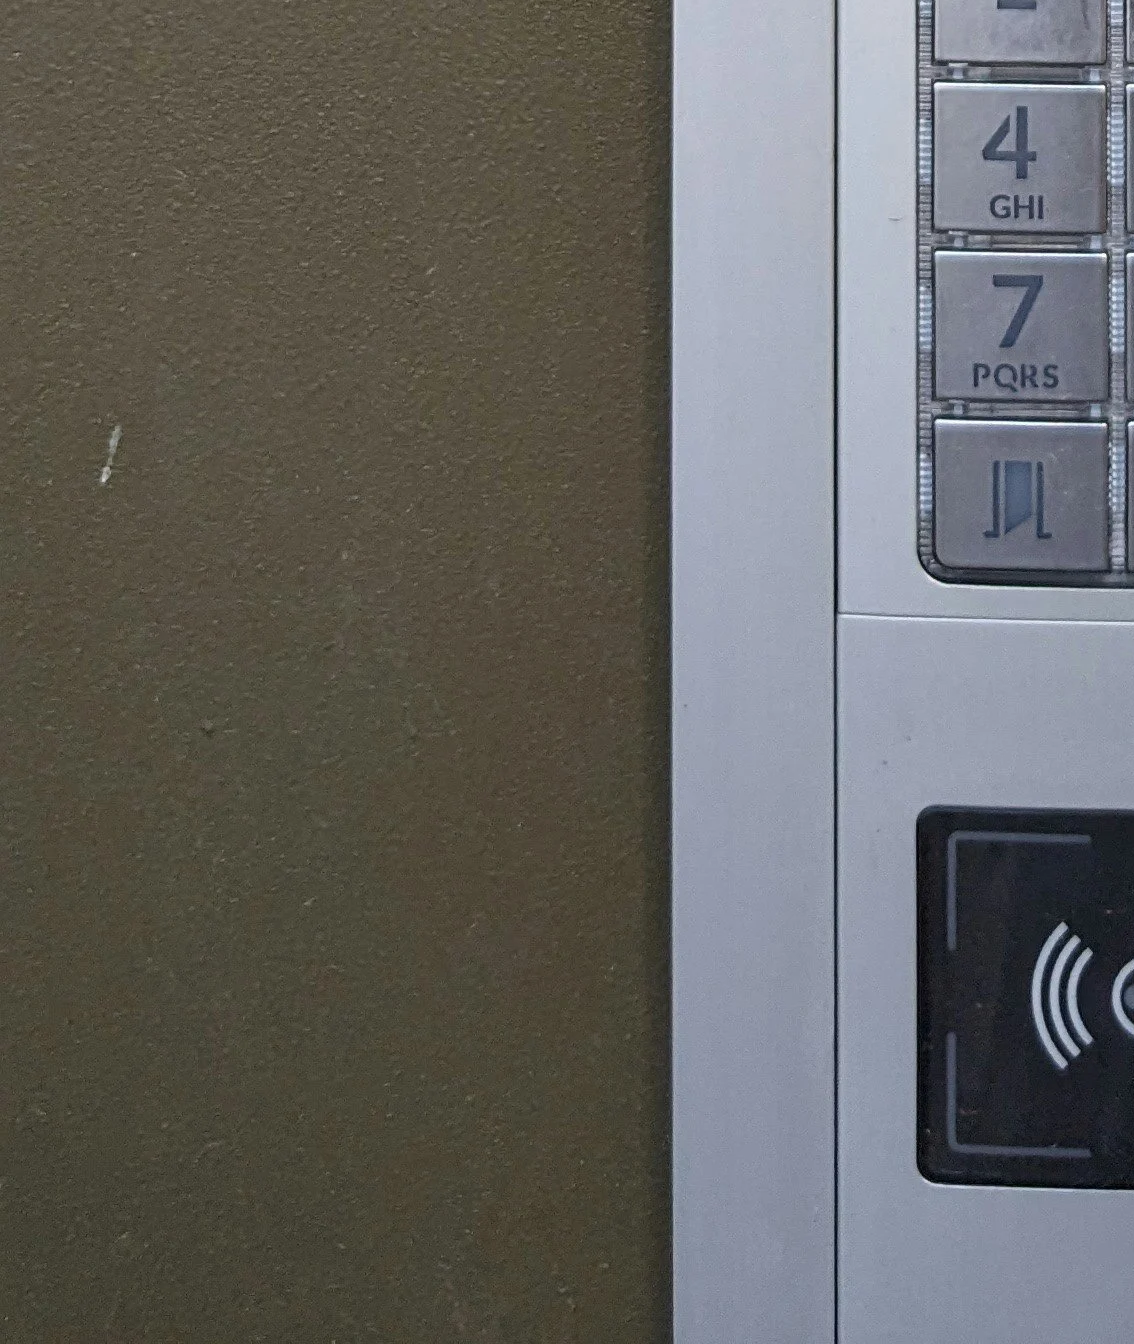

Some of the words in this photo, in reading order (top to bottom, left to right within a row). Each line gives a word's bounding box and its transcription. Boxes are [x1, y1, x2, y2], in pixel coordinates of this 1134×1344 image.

[982, 105, 1037, 180] 4
[990, 195, 1045, 220] GHI
[993, 274, 1043, 348] 7
[973, 364, 1059, 388] PQRS
